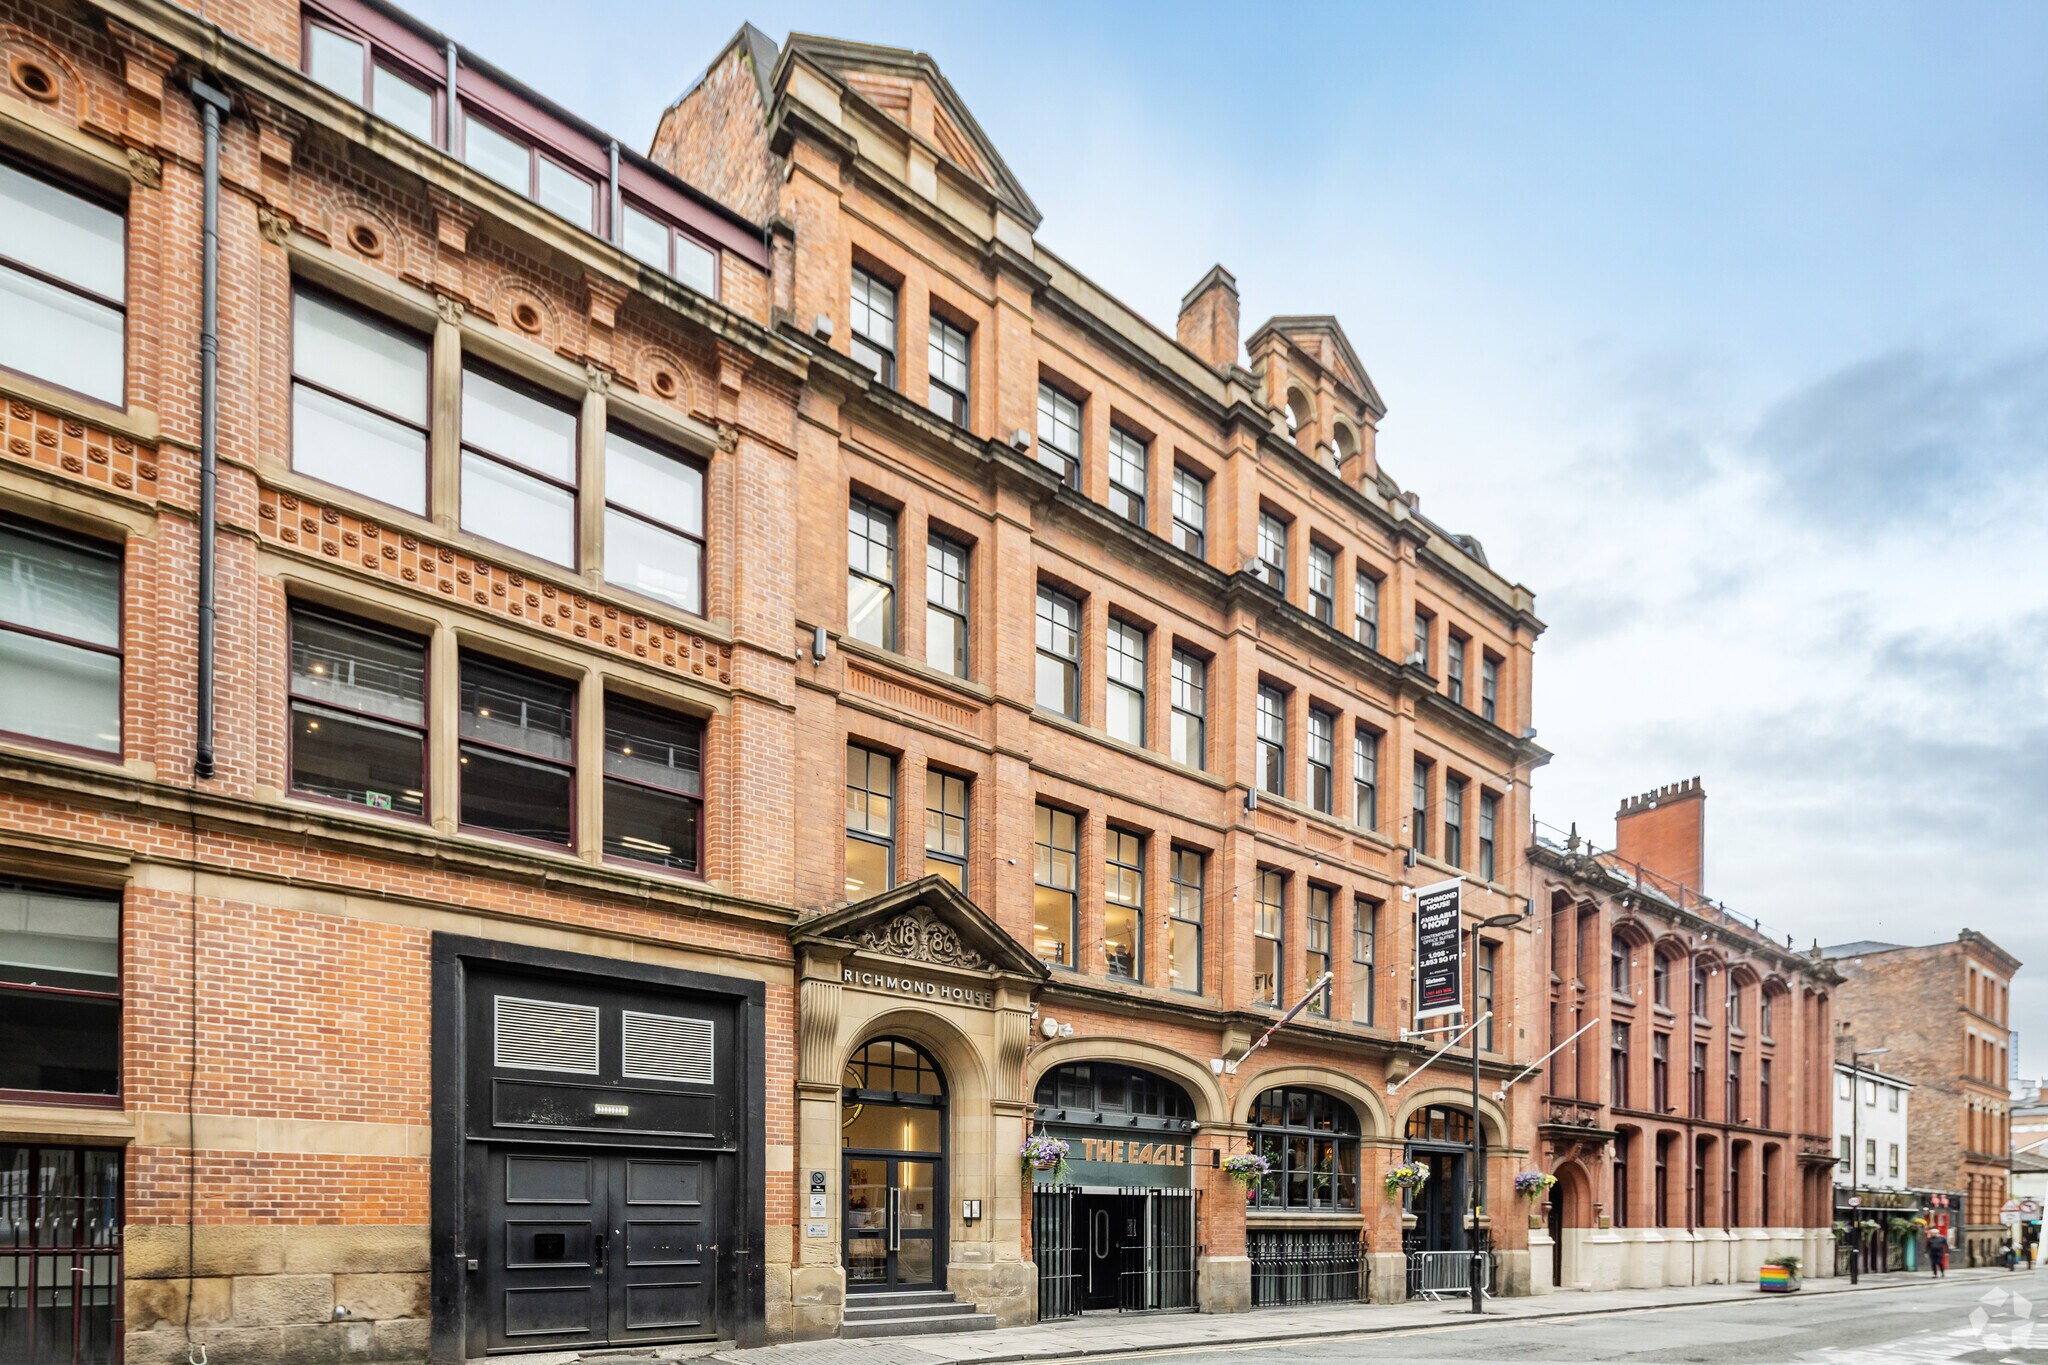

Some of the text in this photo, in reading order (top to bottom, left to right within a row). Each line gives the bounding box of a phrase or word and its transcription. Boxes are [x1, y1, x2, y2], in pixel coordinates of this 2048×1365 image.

[1420, 891, 1458, 907] RICHMOND
[1426, 899, 1451, 912] HOUSE
[1420, 909, 1457, 925] AVAILABLE
[1428, 917, 1449, 930] NOW
[1420, 928, 1457, 941] CONTEMPORARY
[1422, 933, 1455, 945] OFFICE SUITES
[1438, 956, 1449, 964] SQ
[1449, 953, 1458, 961] FT
[843, 969, 992, 1004] RICHMOND HOUSE
[1081, 1138, 1185, 1167] THE EAGLE
